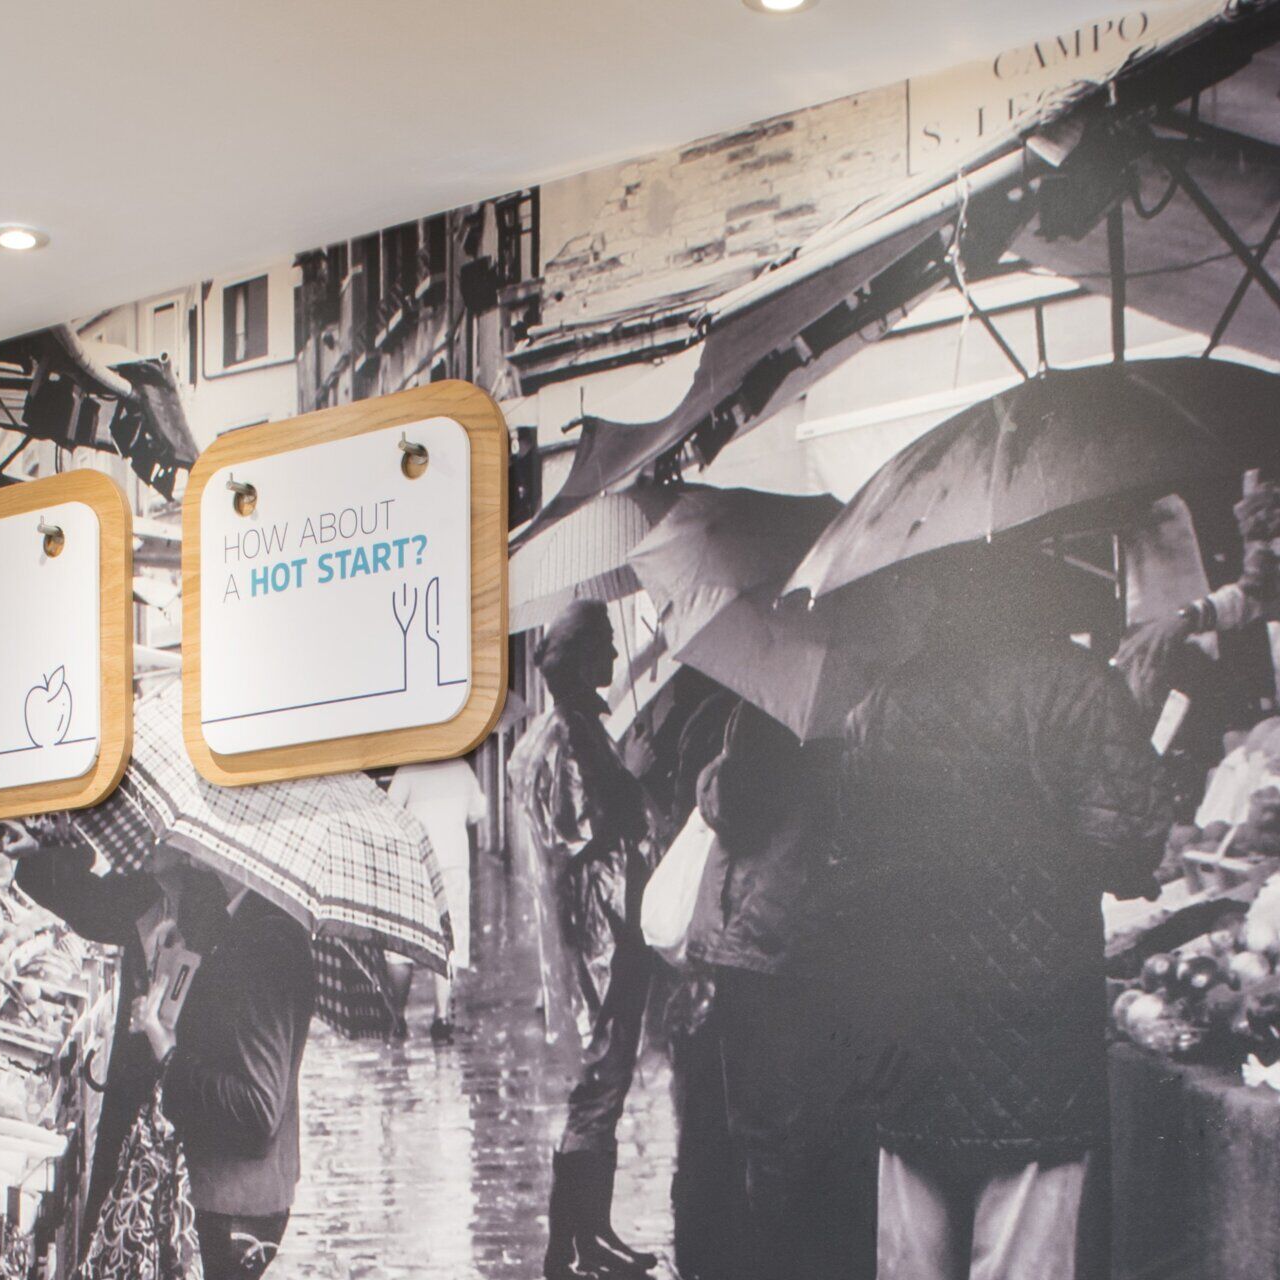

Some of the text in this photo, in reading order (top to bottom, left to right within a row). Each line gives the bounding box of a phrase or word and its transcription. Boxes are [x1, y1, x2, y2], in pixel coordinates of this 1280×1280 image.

[993, 11, 1150, 81] CAMPO
[223, 499, 395, 563] HOW ABOUT
[223, 534, 428, 604] A HOT START?
